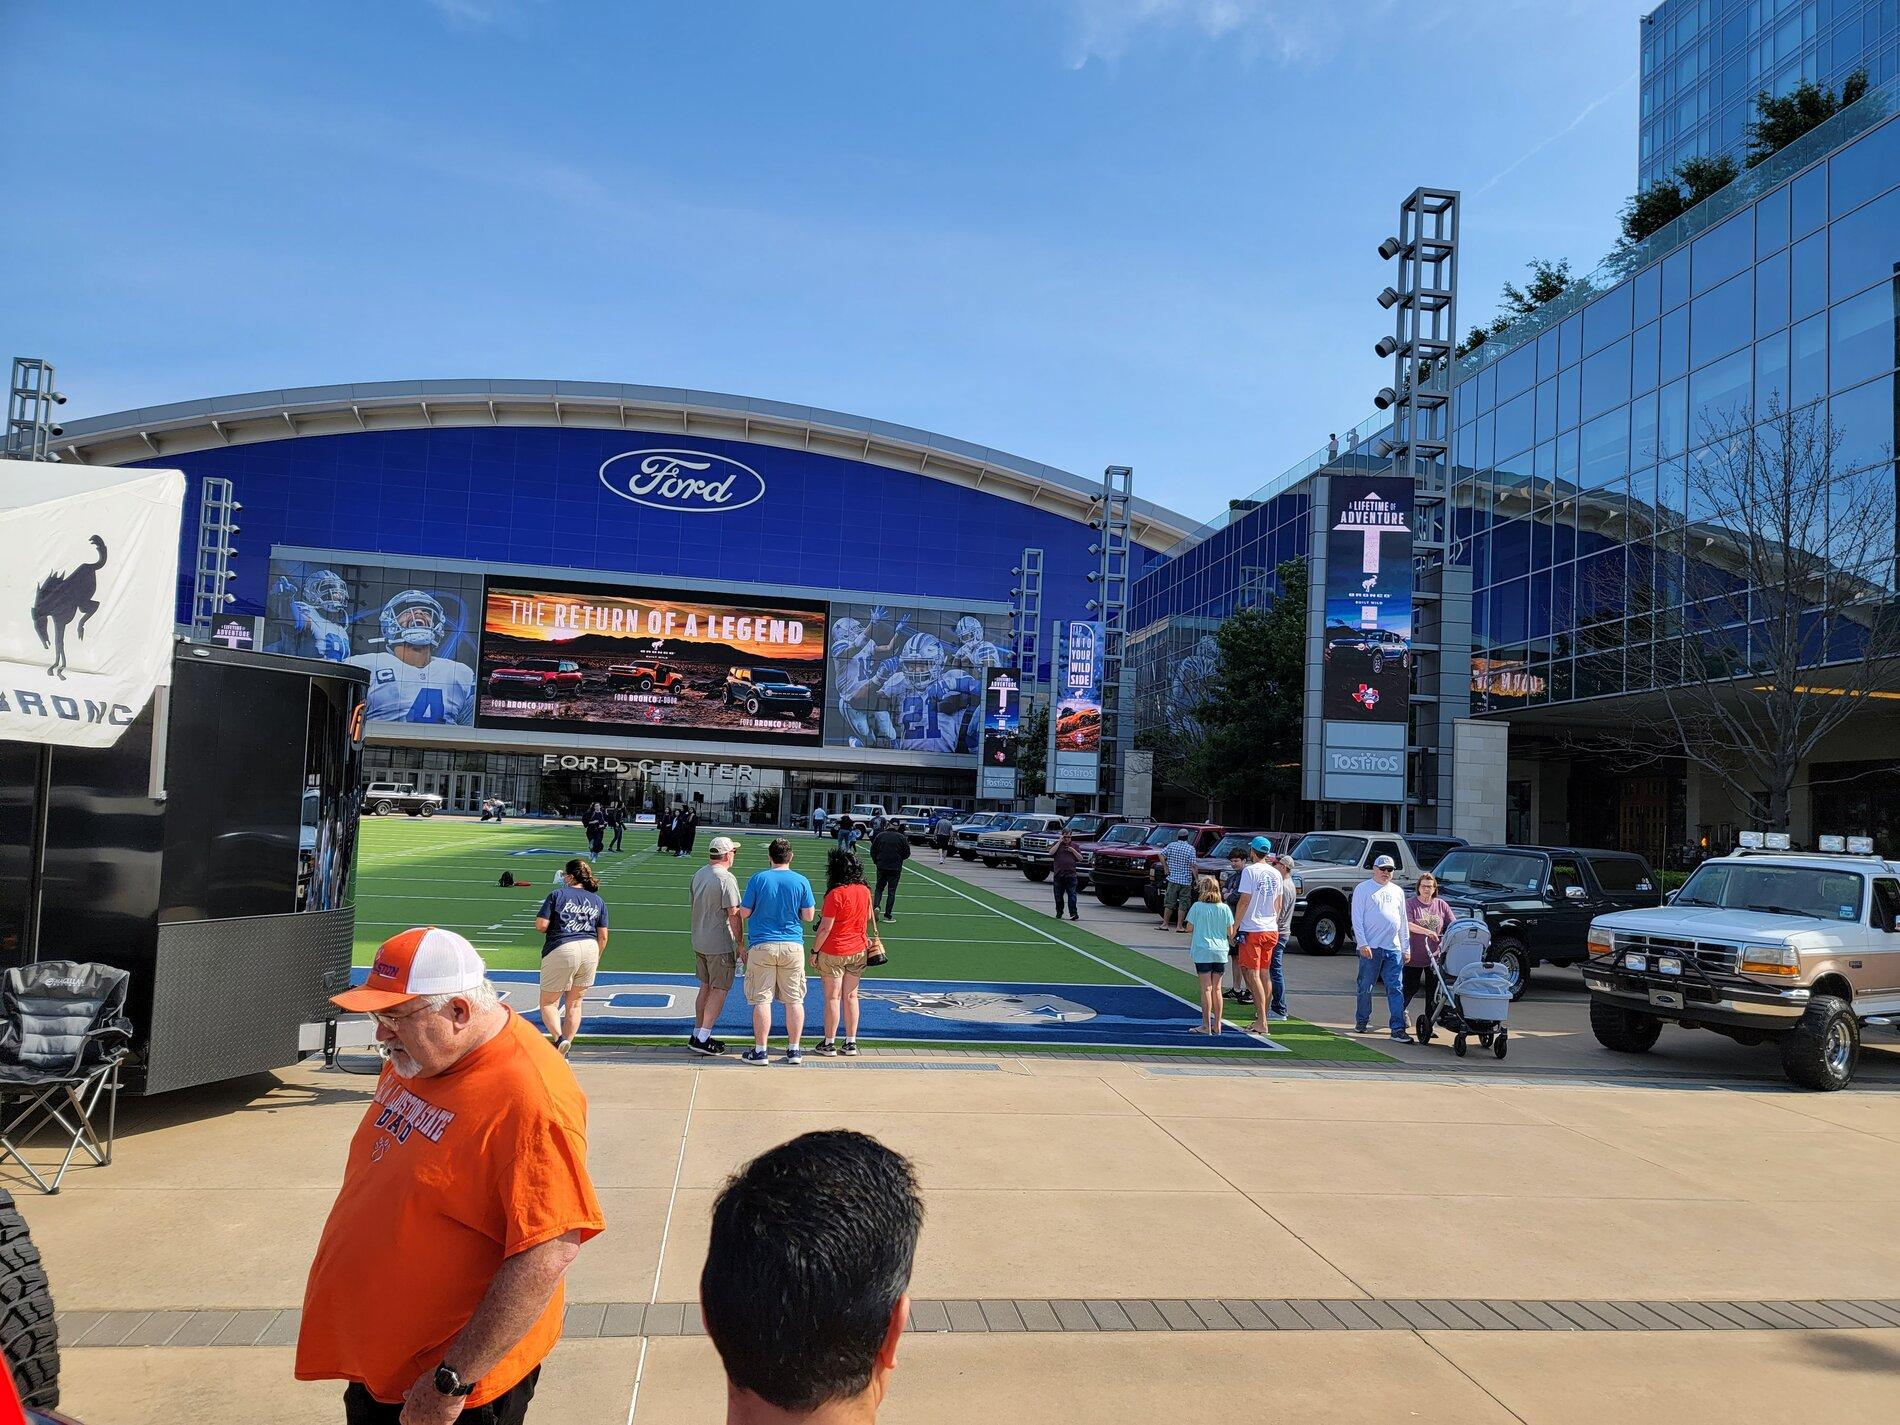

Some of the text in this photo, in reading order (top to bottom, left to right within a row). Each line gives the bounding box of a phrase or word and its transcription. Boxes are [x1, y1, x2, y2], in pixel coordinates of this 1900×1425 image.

[629, 456, 737, 503] Ford
[1353, 500, 1389, 512] LIFETIME
[1340, 510, 1405, 525] ADVENTURE
[511, 600, 804, 645] THE RETURN OF A LEGEND
[216, 629, 250, 638] ADVENTURE
[1072, 625, 1082, 636] TAP
[1072, 637, 1092, 648] INTO
[1071, 649, 1091, 660] YOUR
[1071, 662, 1091, 673] WILD
[1070, 674, 1090, 686] SIDE
[628, 694, 657, 703] BRONCO
[507, 700, 536, 710] BRONCO
[754, 719, 781, 728] BRONCO
[902, 696, 942, 740] 21
[543, 754, 753, 777] FORD CENTER
[373, 1106, 414, 1146] DAD
[413, 1103, 456, 1142] STATE
